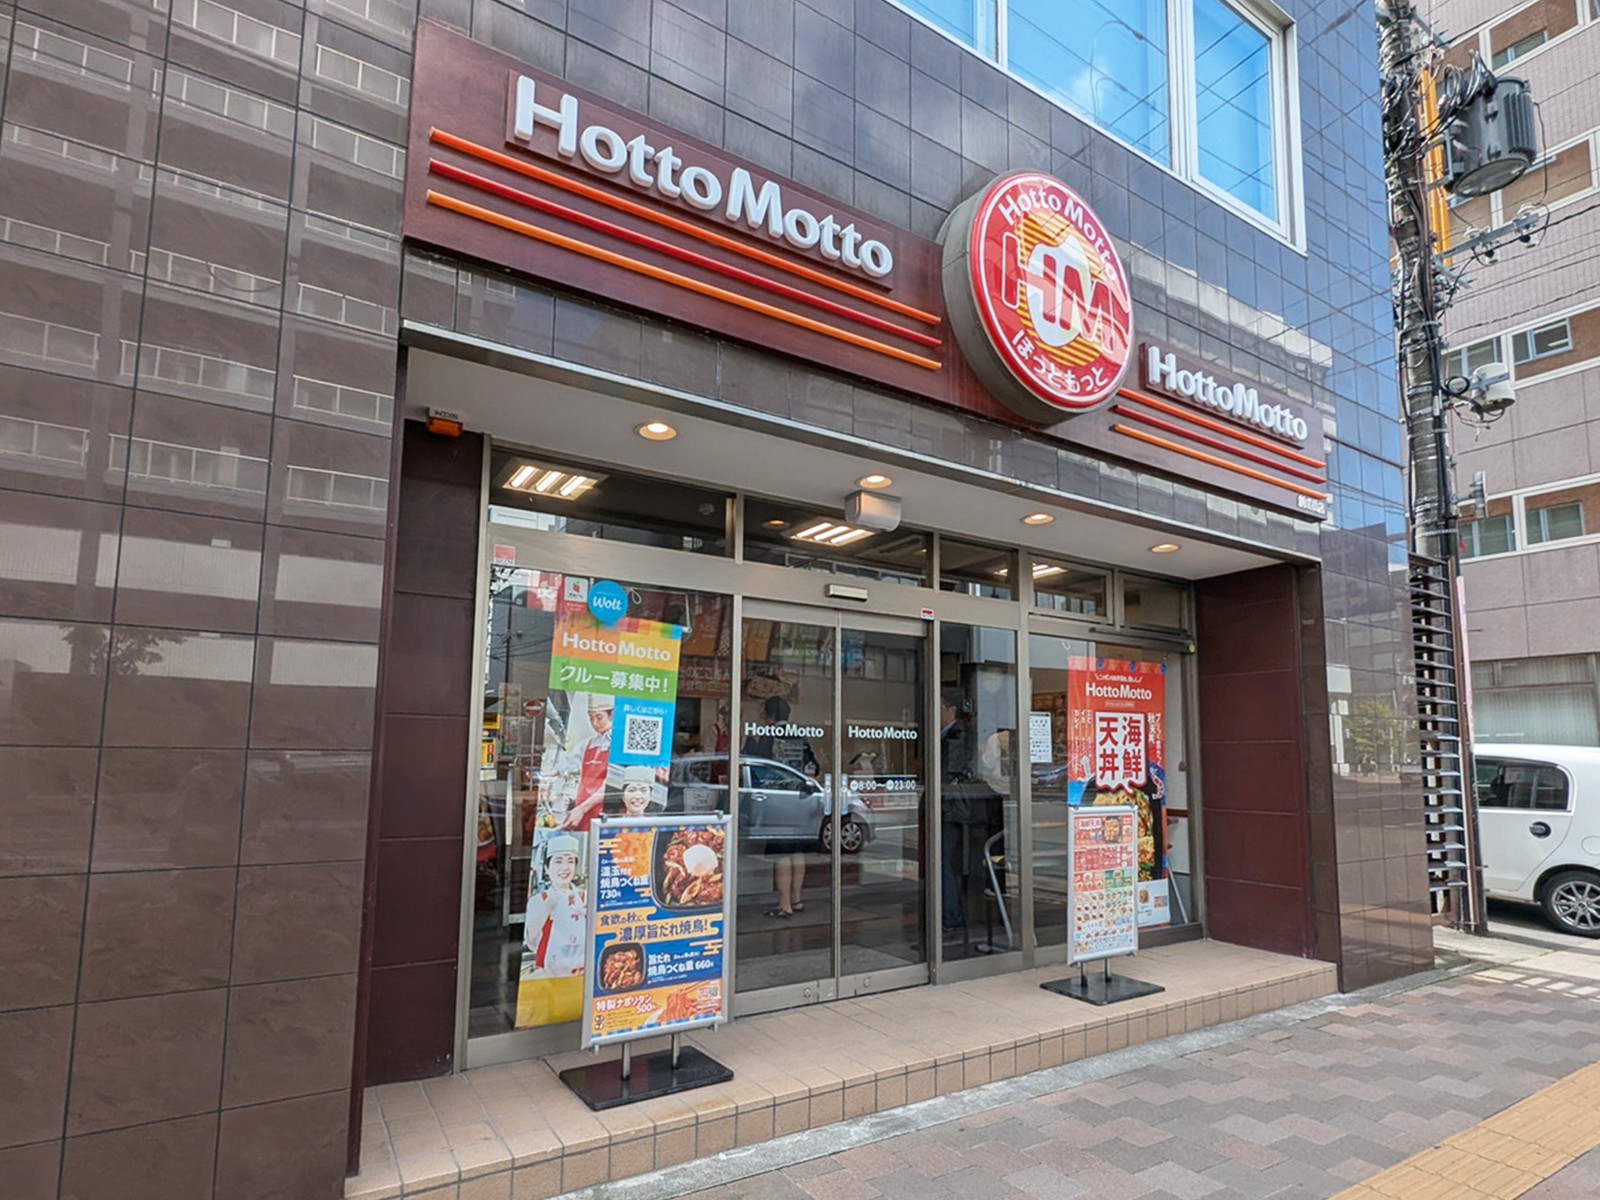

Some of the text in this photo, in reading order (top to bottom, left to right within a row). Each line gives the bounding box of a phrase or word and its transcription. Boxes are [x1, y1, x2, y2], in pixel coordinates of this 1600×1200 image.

[1011, 331, 1110, 393] ほっともっと
[592, 597, 623, 611] Wolt
[559, 665, 669, 693] クルー募集中！
[619, 918, 708, 941] 濃厚旨だれ焼鳥！
